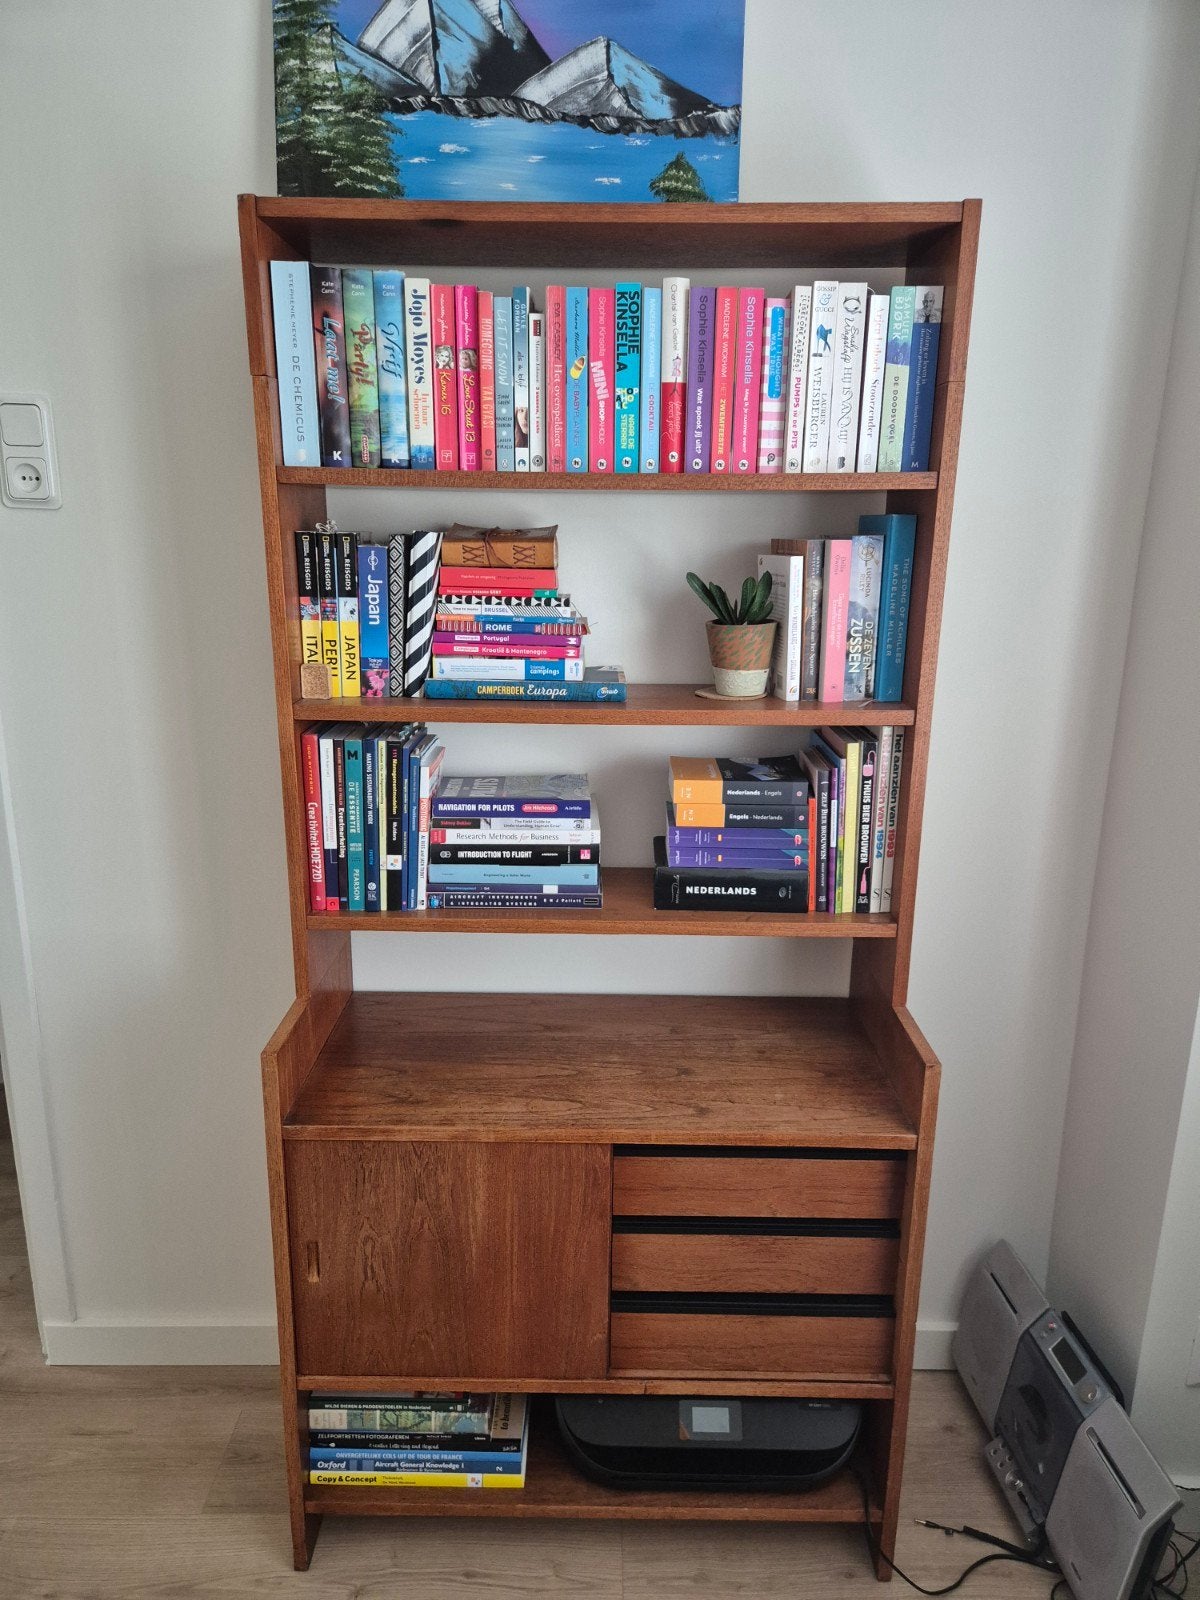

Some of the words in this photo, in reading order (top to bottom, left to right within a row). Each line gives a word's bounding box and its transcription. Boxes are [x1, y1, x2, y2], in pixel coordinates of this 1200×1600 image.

[288, 274, 296, 319] STEPHENIE
[408, 288, 426, 326] Jojo
[597, 296, 606, 324] Sophie
[497, 309, 507, 331] LET
[616, 291, 628, 372] KINSELLA
[628, 290, 640, 354] SOPHIE
[698, 295, 708, 336] Sophie
[722, 298, 731, 339] MADELEINE
[746, 296, 756, 336] Sophie
[799, 299, 807, 336] LISELORE
[891, 295, 904, 340] BJØRK
[903, 295, 911, 340] SAMUEL
[322, 317, 342, 361] Laat
[350, 323, 374, 387] Party!
[381, 322, 403, 378] Vrij
[482, 318, 492, 369] HOMEGOING
[498, 336, 506, 346] IT
[794, 339, 803, 369] ALBERS
[292, 356, 300, 372] DE
[411, 332, 428, 384] Moyes
[498, 352, 508, 385] SNOW
[554, 364, 562, 383] Het
[697, 340, 707, 382] Kinsella
[721, 341, 729, 377] WICKHAM
[744, 341, 754, 384] Kinsella
[326, 366, 345, 404] me!
[440, 371, 450, 401] Kamer
[463, 374, 474, 399] Love
[483, 386, 492, 401] YAA
[591, 360, 609, 399] MINI
[793, 377, 801, 407] PUMPS
[894, 376, 900, 386] DE
[293, 376, 305, 442] CHEMICUS
[413, 388, 422, 429] schoenen
[422, 393, 429, 402] In
[441, 404, 450, 415] 16
[464, 400, 474, 428] Street
[809, 367, 822, 448] WEISBERGER
[820, 393, 828, 425] LAUREN
[866, 379, 880, 437] Stoorzender
[553, 385, 562, 447] overspeldieet
[694, 406, 703, 429] spook
[718, 399, 726, 455] ZWEMFEESTJE
[888, 390, 899, 444] DOODSVOGEL
[466, 431, 475, 442] 13
[628, 438, 635, 449] DE
[365, 574, 383, 625] Japan
[864, 568, 872, 598] LUCINDA
[889, 564, 898, 615] MADELINE
[865, 621, 874, 635] DE
[900, 606, 906, 618] OF
[483, 635, 509, 643] Portugal
[848, 618, 863, 673] ZUSSEN
[862, 638, 873, 670] ZEVEN
[886, 620, 894, 656] MILLER
[895, 621, 904, 664] ACHILLES
[345, 636, 356, 680] JAPAN
[530, 668, 560, 676] campings
[477, 686, 524, 695] CAMPERBOEK
[527, 686, 567, 696] Europa
[883, 734, 892, 753] het
[894, 734, 903, 753] het
[349, 782, 355, 792] DE
[863, 780, 872, 803] THUIS
[879, 755, 889, 804] aanzien
[889, 755, 900, 804] aanzien
[862, 805, 871, 823] BIER
[888, 806, 896, 827] van
[518, 833, 529, 841] for
[860, 824, 870, 863] BROUWEN
[876, 829, 884, 858] 1994
[887, 828, 896, 858] 1993
[686, 886, 757, 895] NEDERLANDS
[317, 1461, 346, 1469] Oxford
